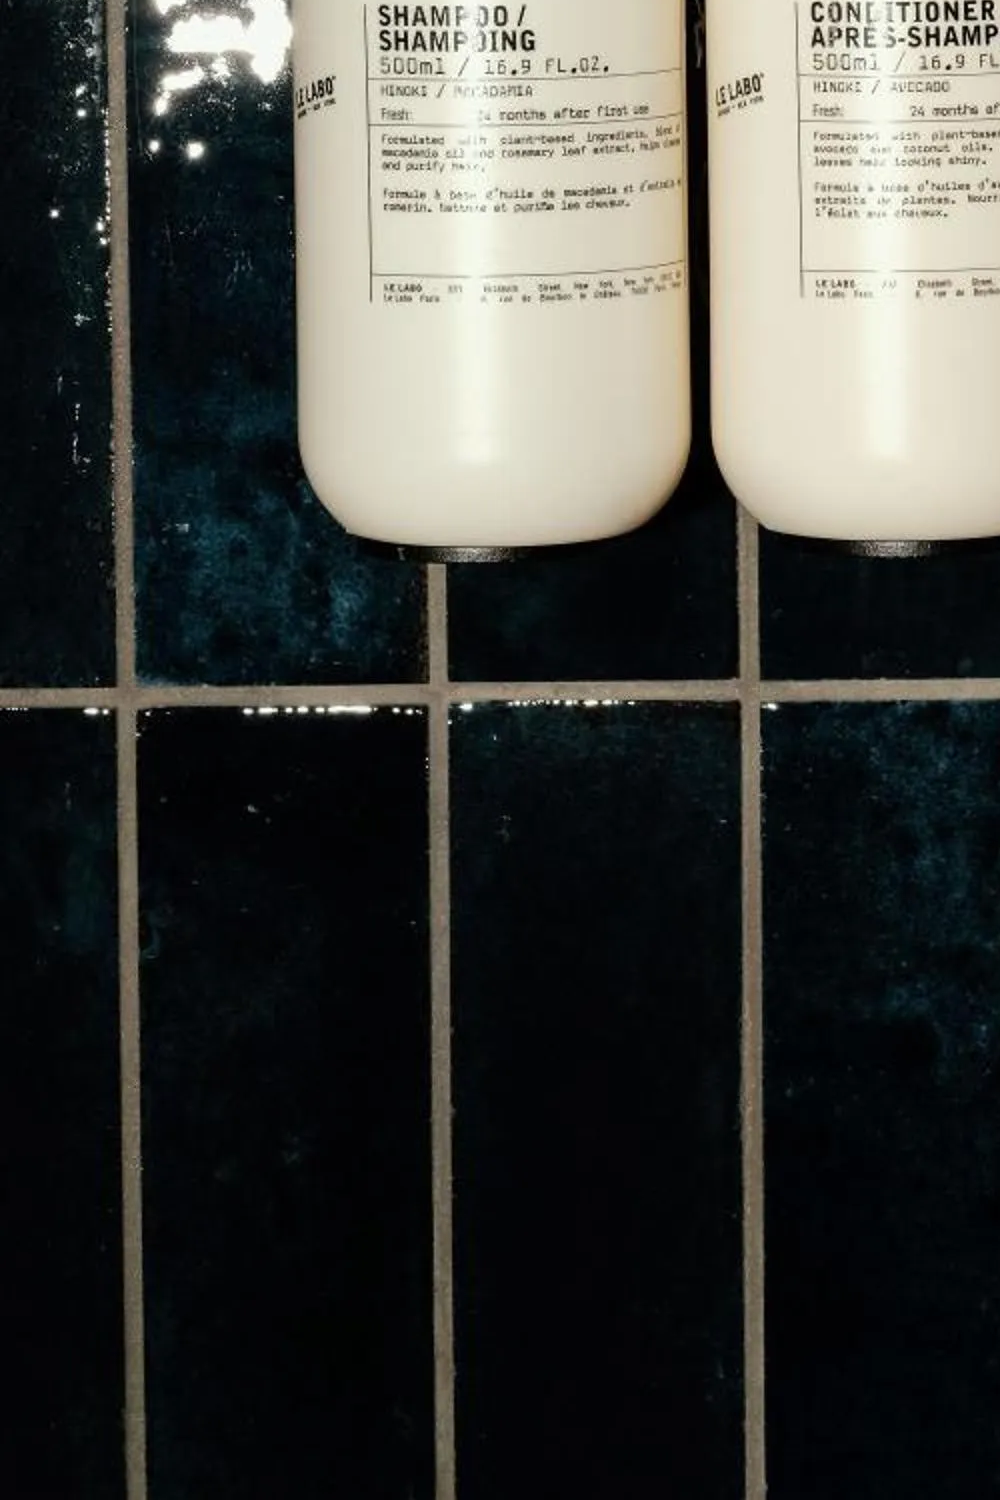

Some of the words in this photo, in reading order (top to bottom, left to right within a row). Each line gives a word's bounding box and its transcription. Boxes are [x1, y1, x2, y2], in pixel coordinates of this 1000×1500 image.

[379, 29, 536, 53] SHAMPOING
[380, 56, 446, 75] 500ml
[484, 59, 531, 75] 16.9
[813, 53, 880, 72] 500ml
[919, 53, 965, 71] 16.9
[728, 73, 761, 101] LABO
[553, 106, 591, 121] after
[597, 104, 629, 117] first
[932, 103, 979, 117] months
[406, 160, 445, 173] purify
